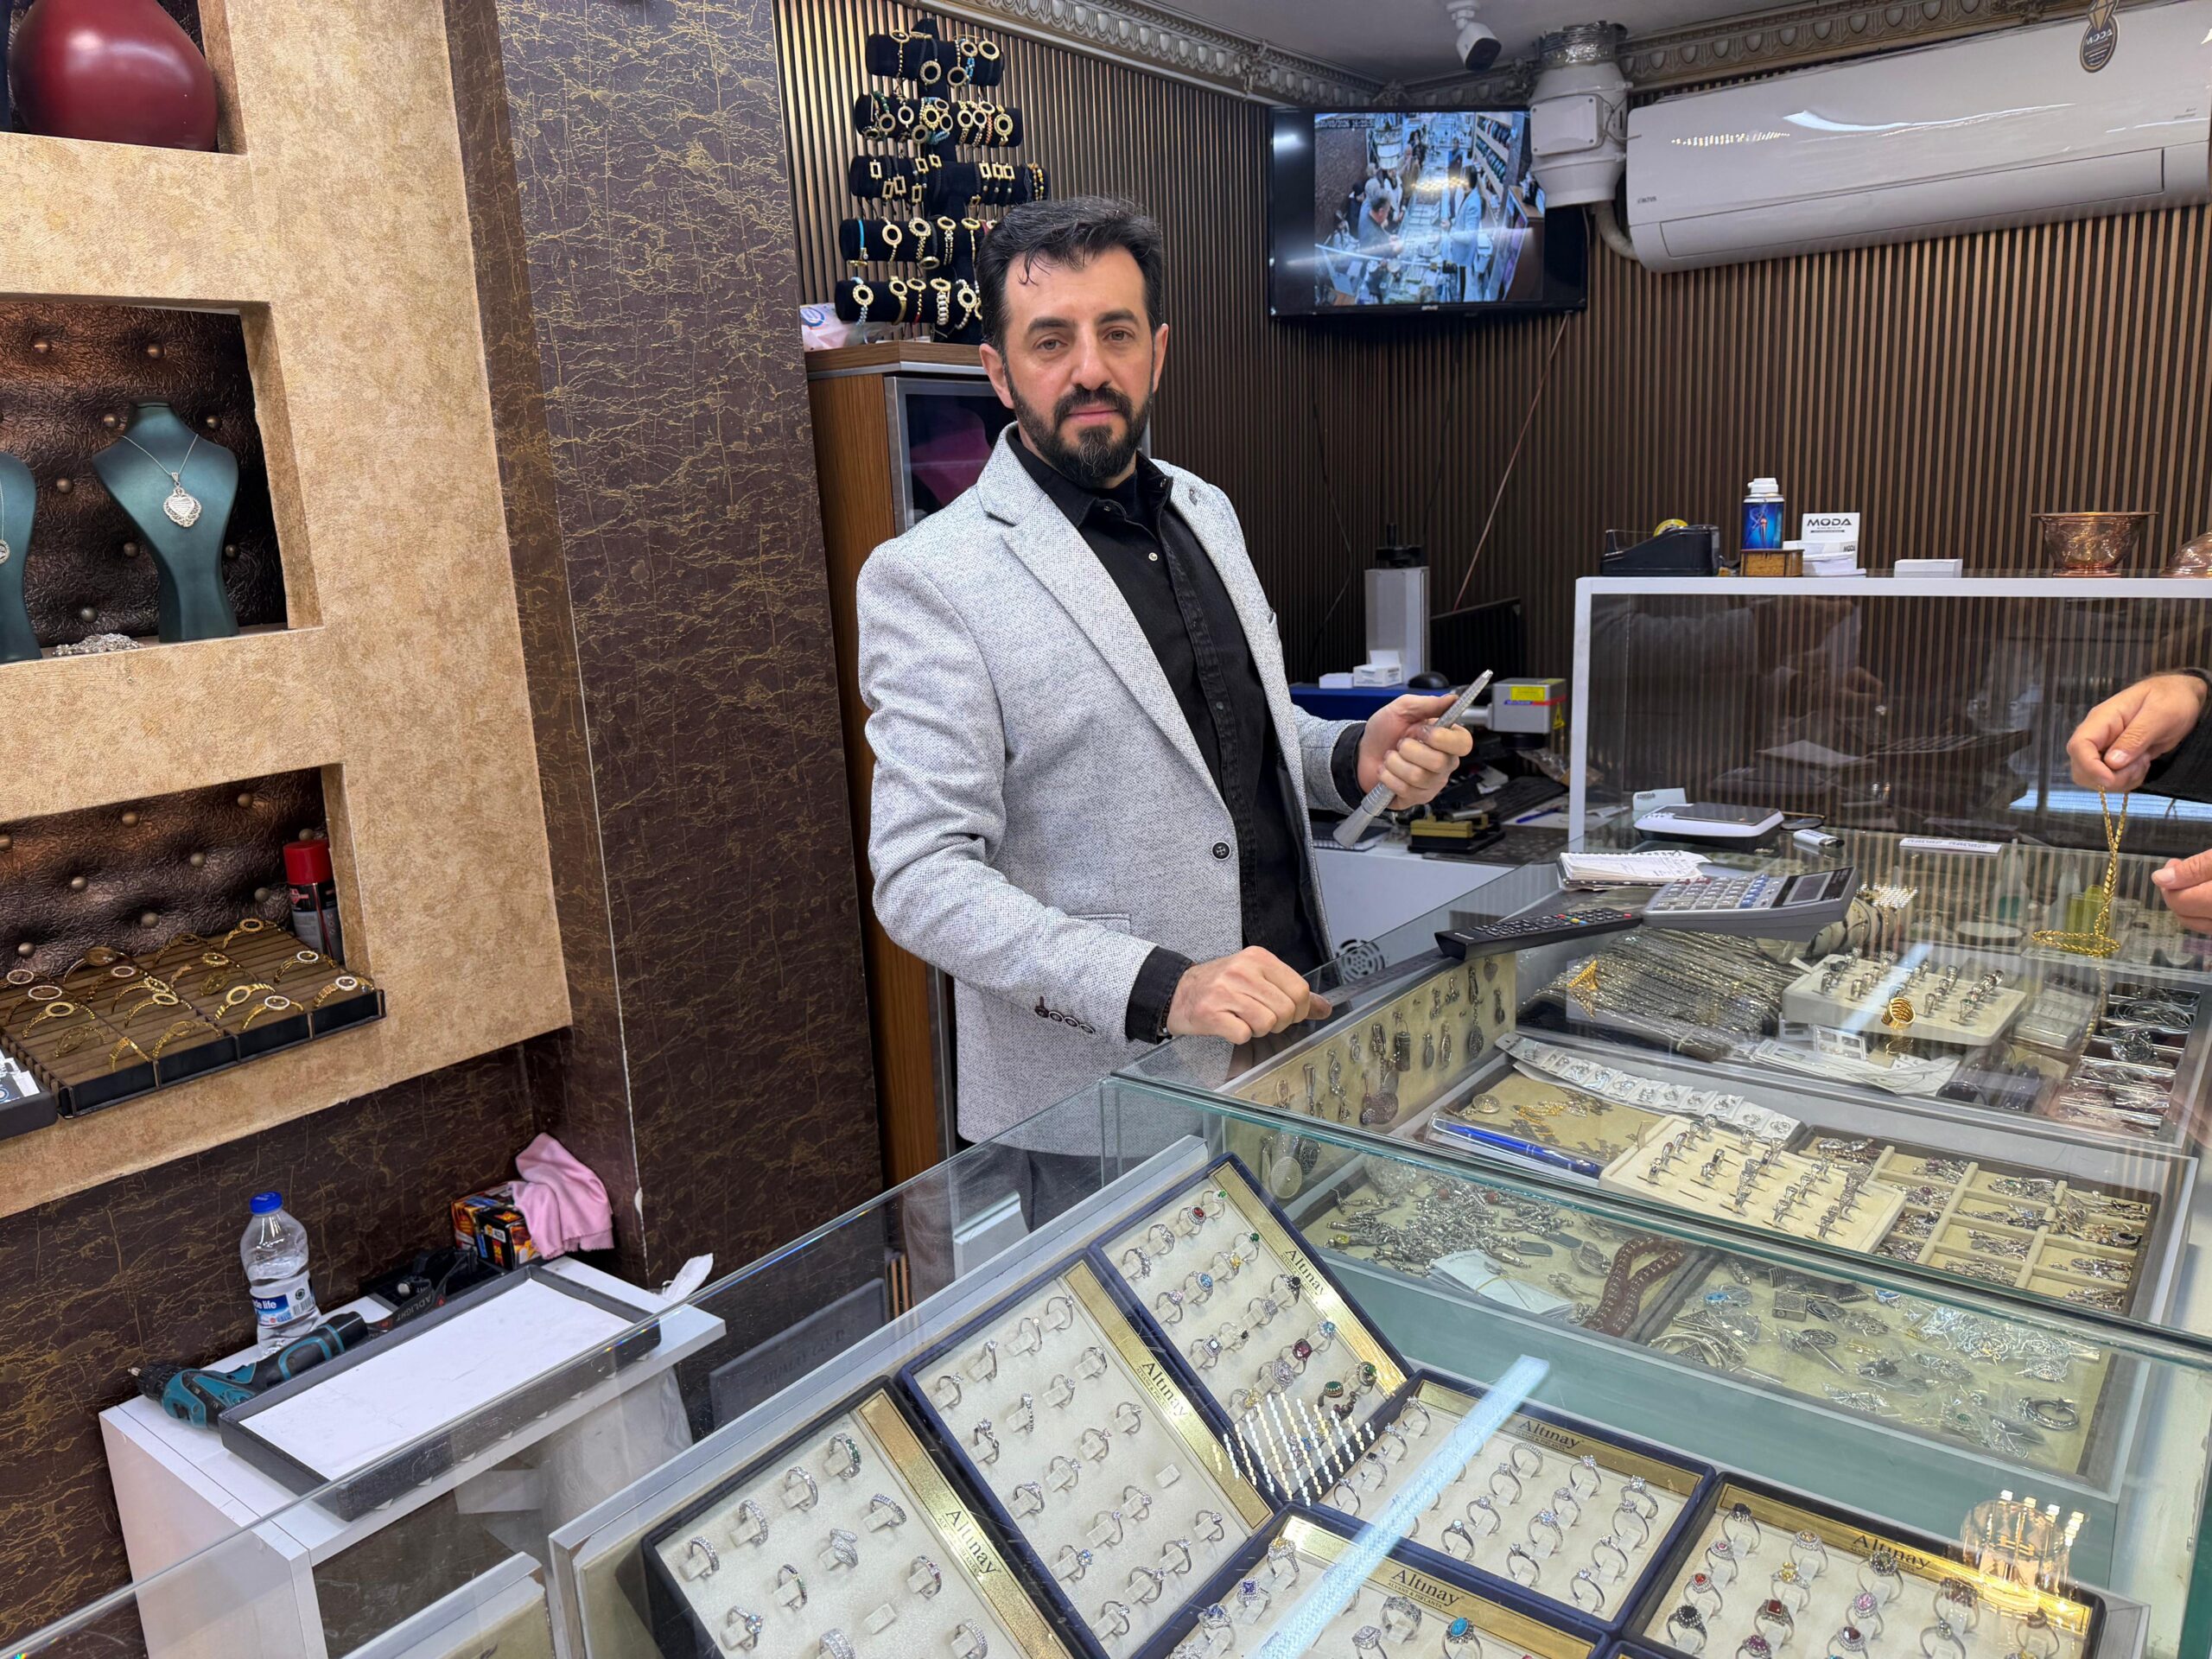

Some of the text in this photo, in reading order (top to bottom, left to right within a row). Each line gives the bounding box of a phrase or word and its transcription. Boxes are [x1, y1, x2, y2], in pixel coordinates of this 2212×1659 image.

[1807, 518, 1852, 526] MODA
[263, 1300, 276, 1309] life
[396, 1293, 432, 1321] ADLIGHT
[1516, 1420, 1580, 1449] Altınay
[945, 1510, 997, 1574] Altınay
[1387, 1580, 1408, 1594] ALYANS
[1414, 1592, 1443, 1610] PIRLANTA
[1391, 1569, 1460, 1606] Altınay
